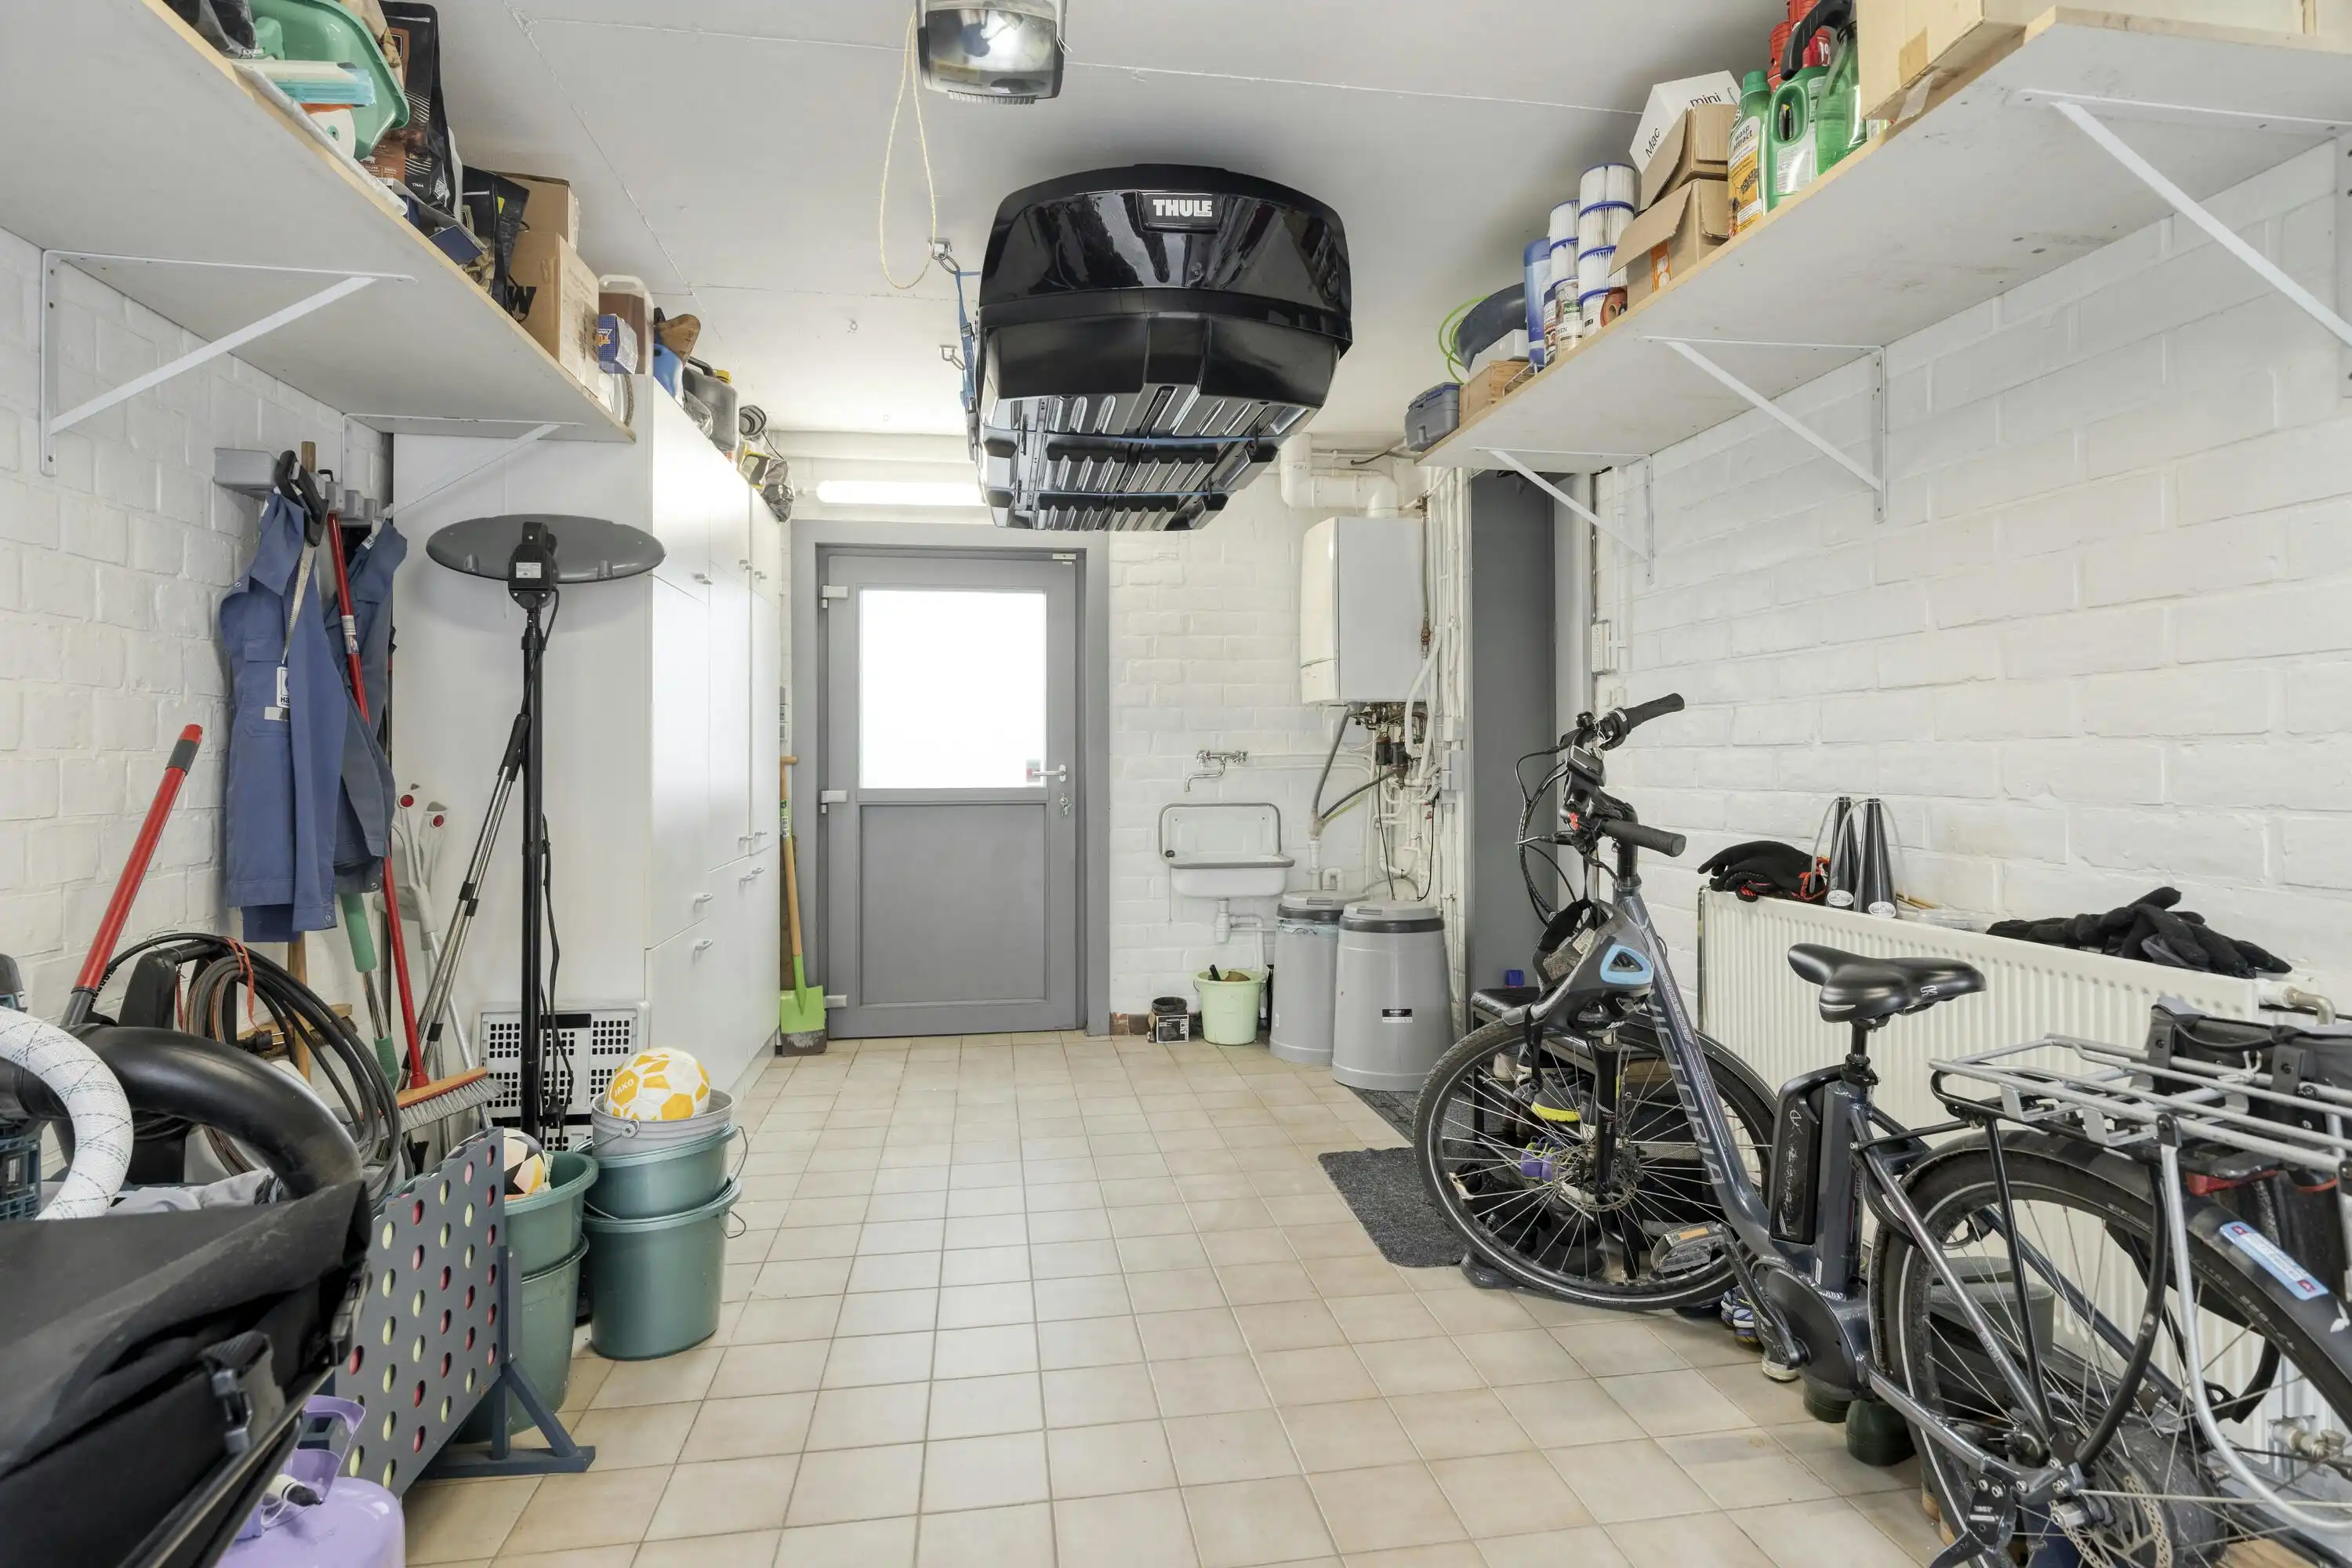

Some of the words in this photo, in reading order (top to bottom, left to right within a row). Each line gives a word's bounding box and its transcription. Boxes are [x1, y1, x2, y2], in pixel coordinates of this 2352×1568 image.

[1690, 93, 1722, 107] mini
[1645, 128, 1661, 158] Mac
[1733, 130, 1753, 152] attract
[1735, 124, 1750, 142] wasp
[1152, 199, 1213, 217] THULE
[1662, 973, 1678, 1004] VICTORIA
[1676, 1010, 1693, 1044] VICTORIA
[615, 1078, 634, 1098] JAKO
[1646, 989, 1726, 1184] VICTORIA
